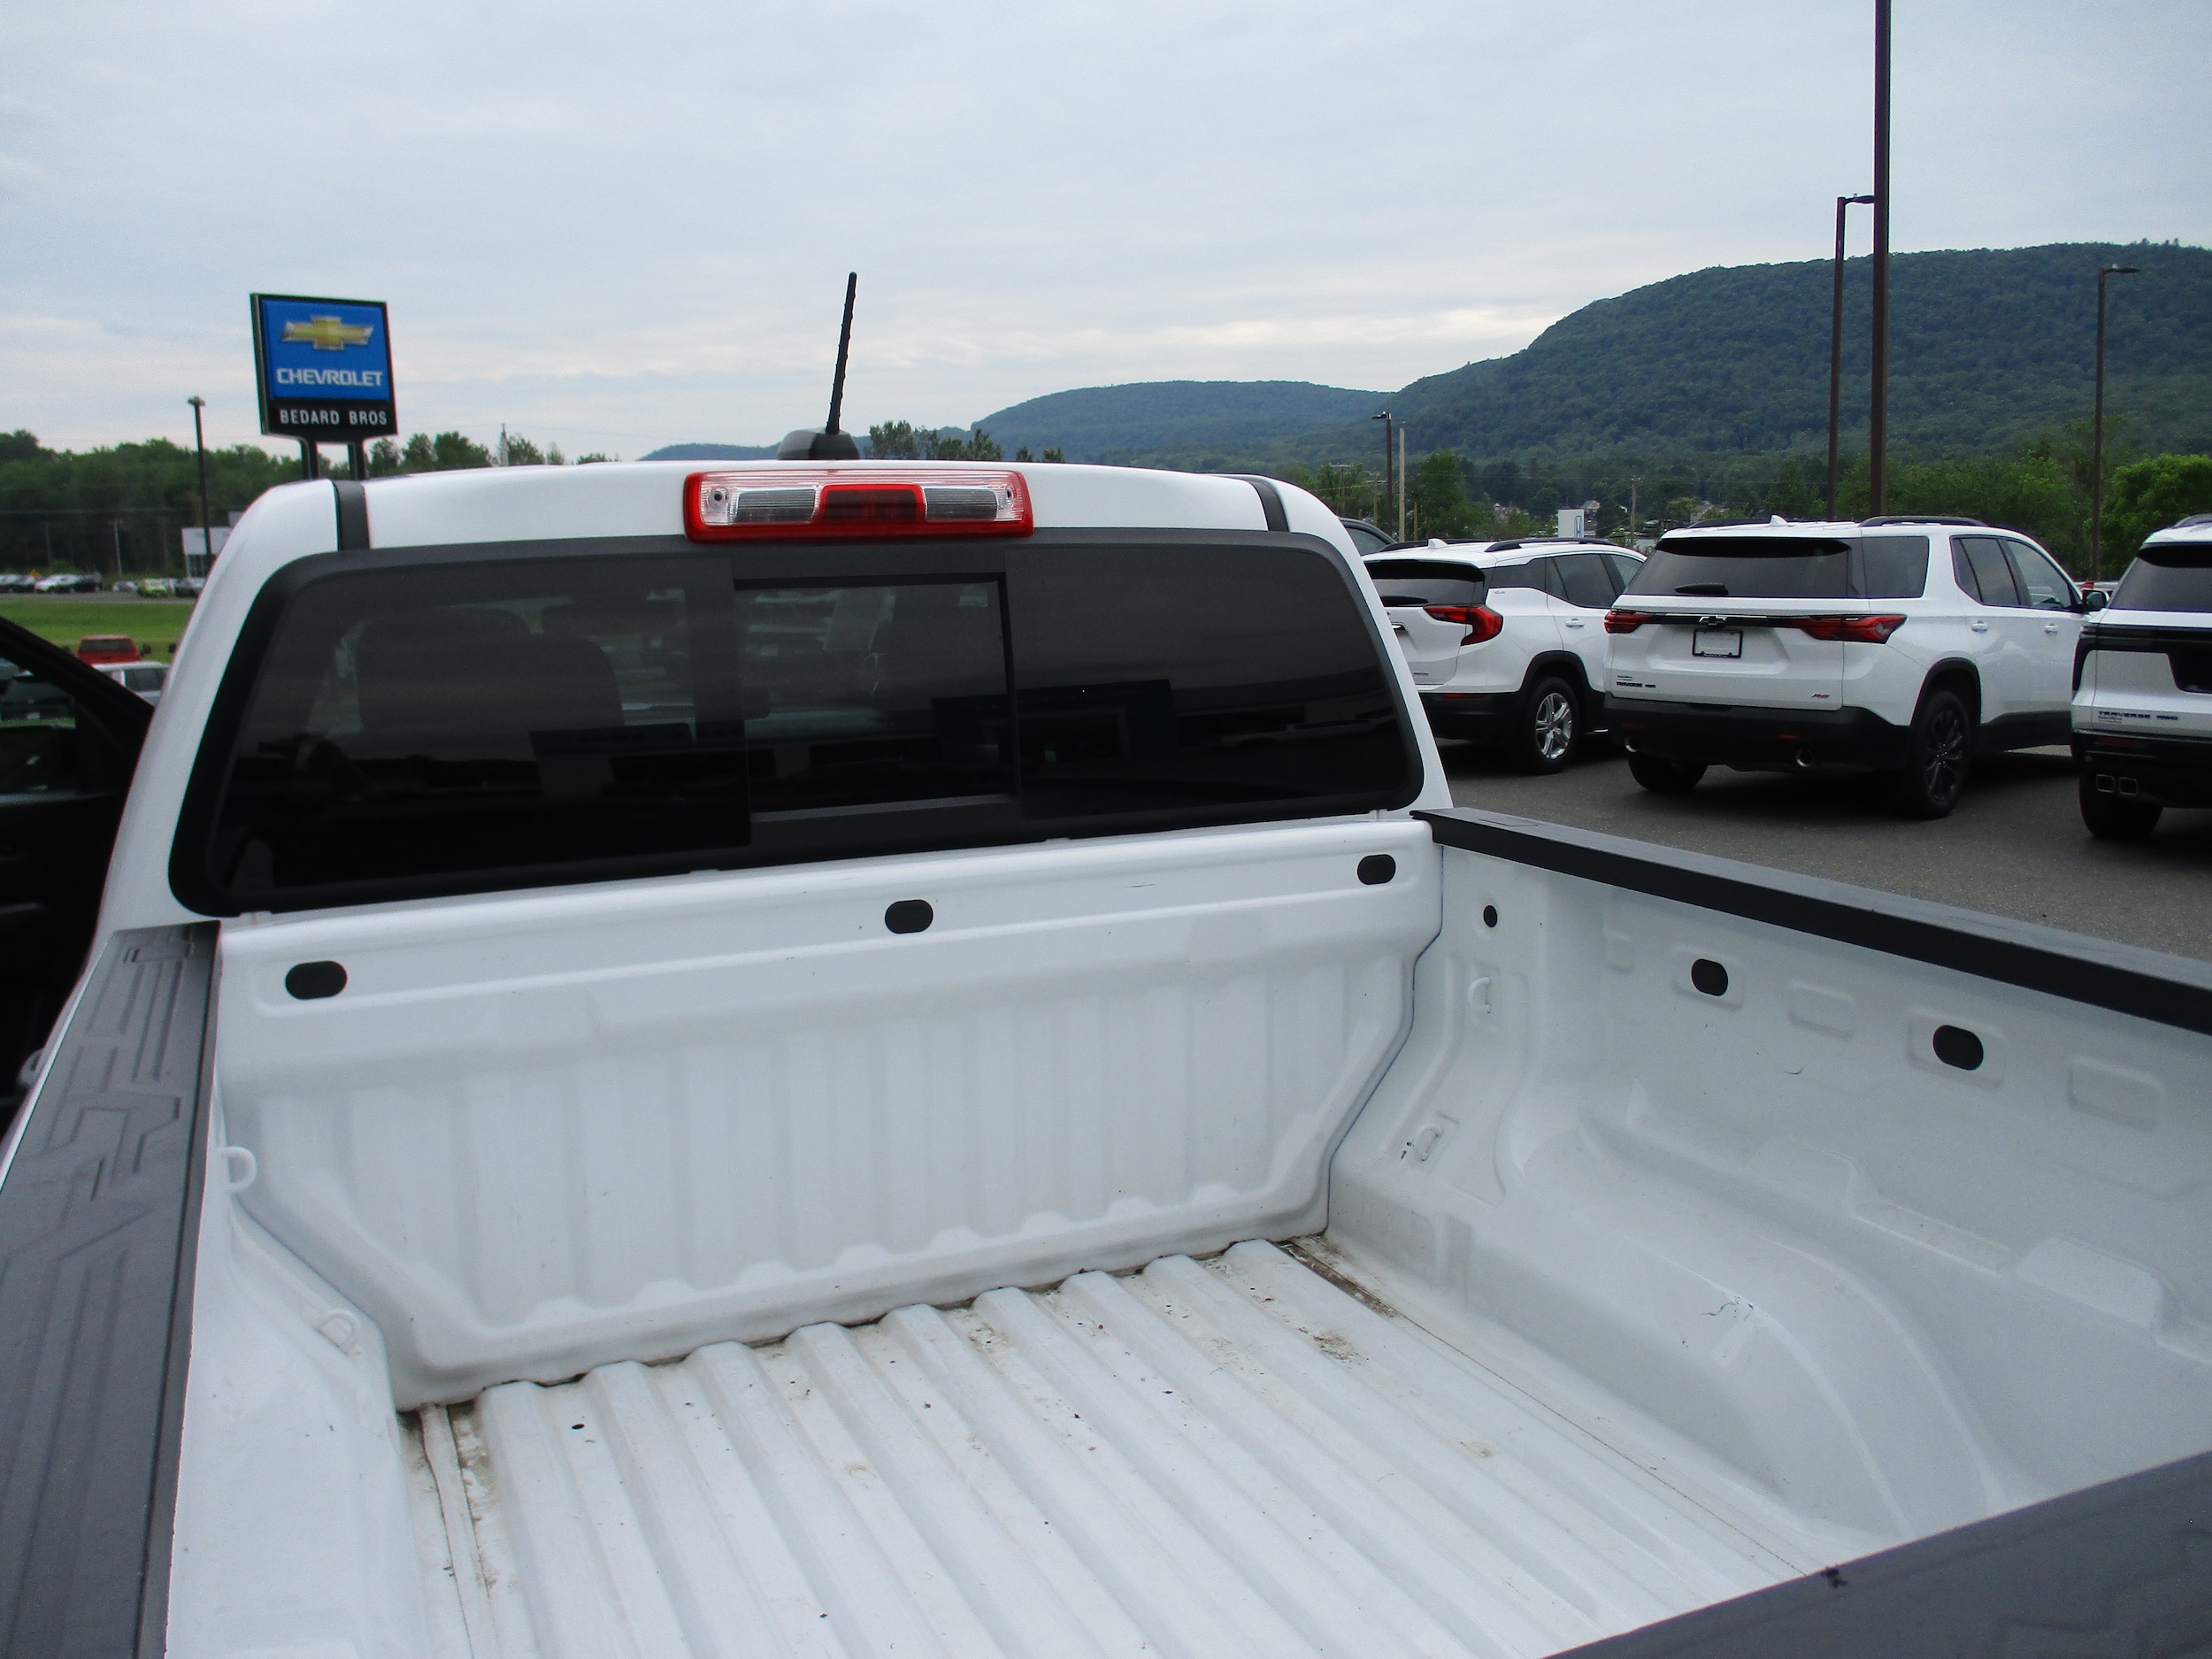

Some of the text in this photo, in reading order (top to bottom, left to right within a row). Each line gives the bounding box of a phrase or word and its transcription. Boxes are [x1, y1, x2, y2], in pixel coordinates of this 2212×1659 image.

[276, 368, 383, 387] CHEVROLET
[280, 409, 388, 426] BEDARD BROS
[2099, 710, 2151, 719] TRAVERSE
